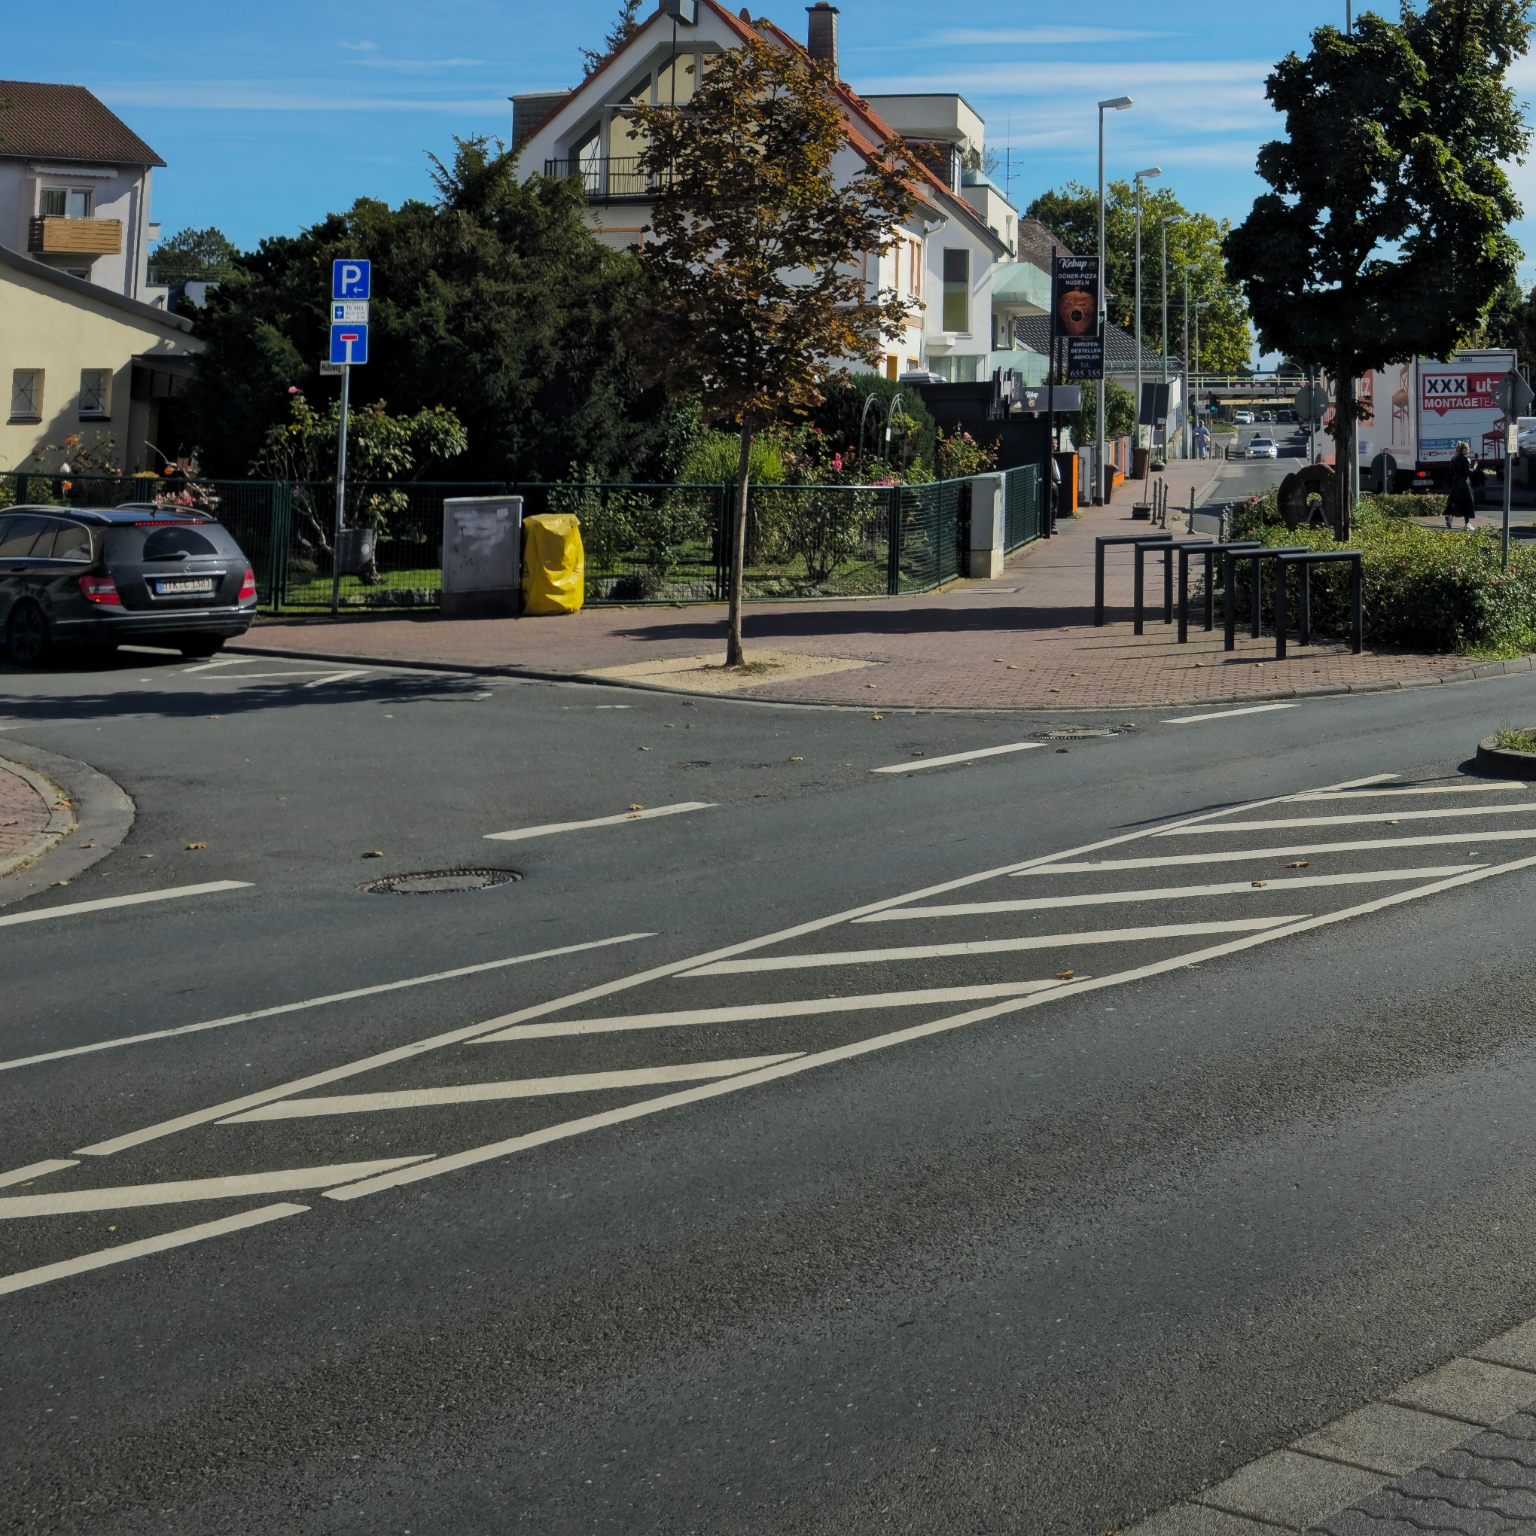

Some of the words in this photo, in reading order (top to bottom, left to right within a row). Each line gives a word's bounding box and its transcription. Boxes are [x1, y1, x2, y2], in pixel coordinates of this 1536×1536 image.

[1059, 258, 1088, 271] Kebap
[341, 265, 362, 295] P
[1070, 369, 1085, 378] 655
[1086, 369, 1101, 378] 355
[1424, 397, 1498, 408] MONTAGETEA
